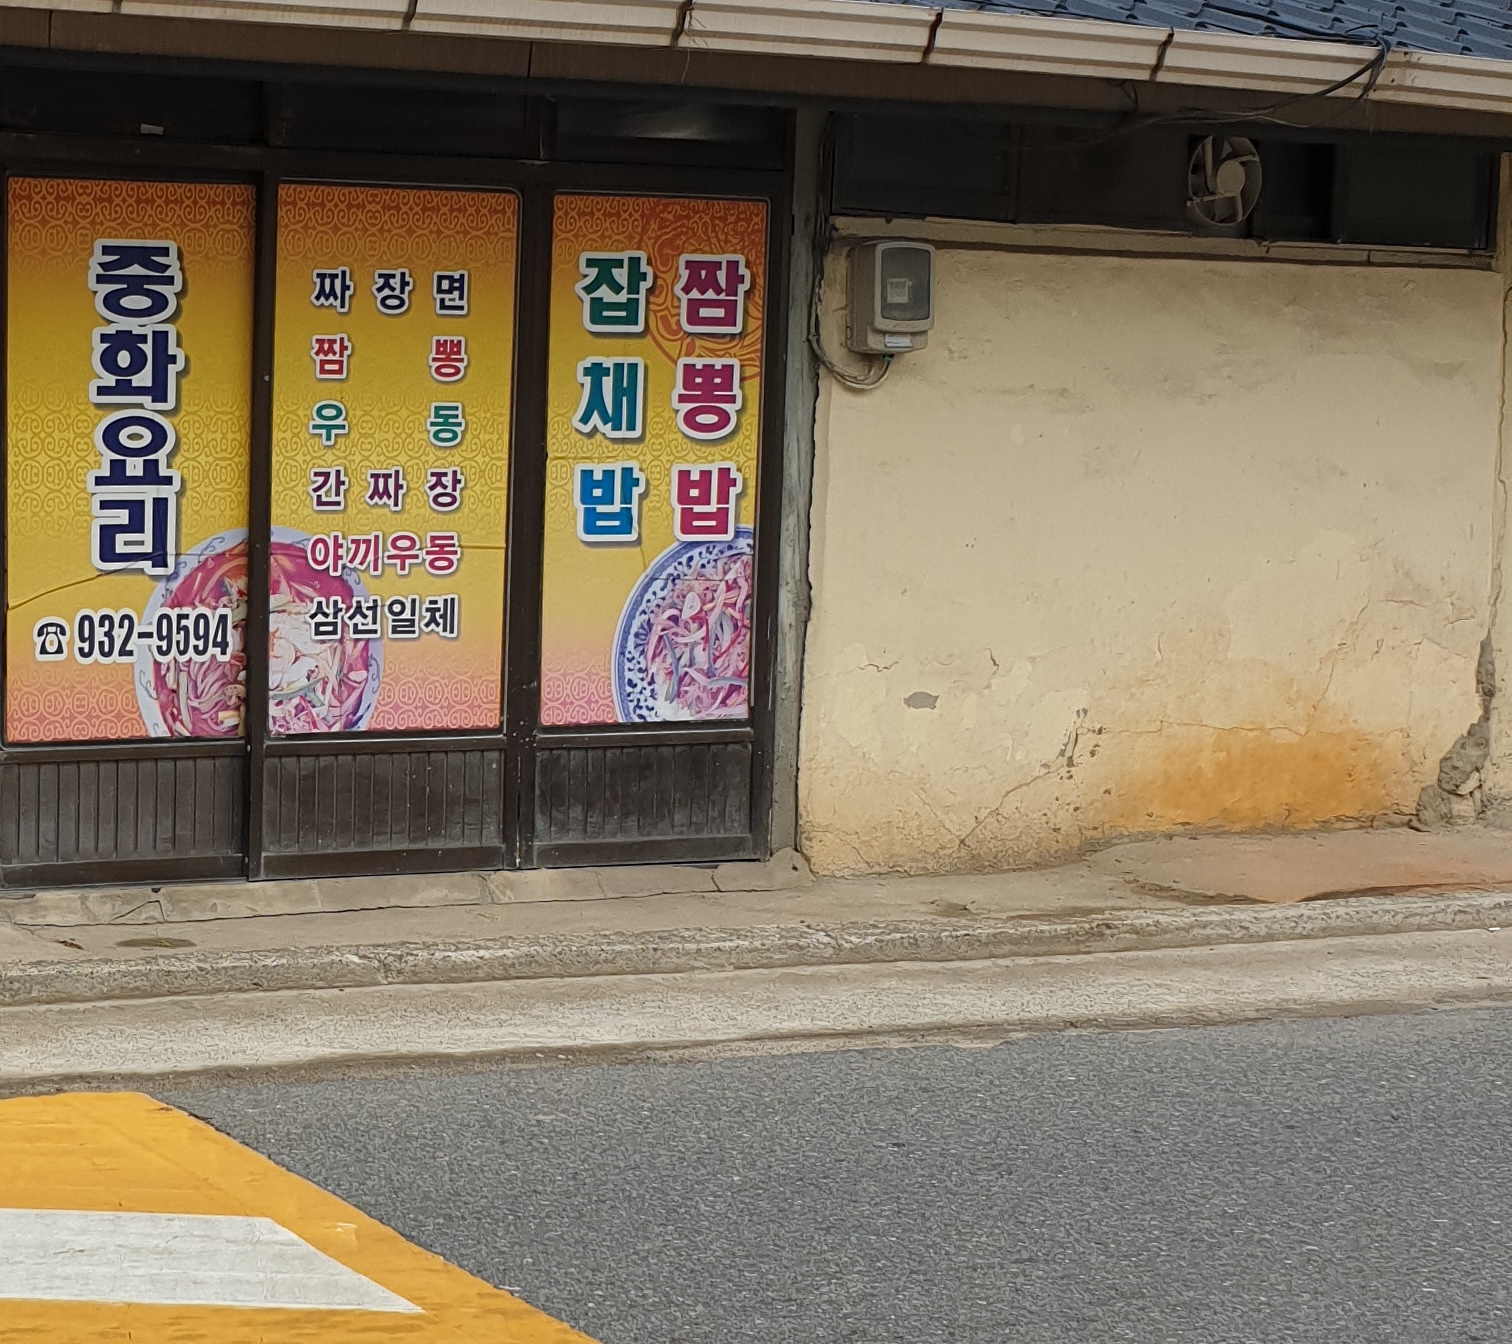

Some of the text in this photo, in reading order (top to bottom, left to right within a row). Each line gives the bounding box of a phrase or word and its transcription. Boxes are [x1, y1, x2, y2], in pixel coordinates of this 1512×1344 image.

[312, 268, 467, 314] 짜장면
[312, 337, 468, 379] 짬뽕
[93, 242, 178, 570] 중화요리
[575, 254, 650, 538] 잡채밥
[674, 257, 747, 538] 짬뽕밥
[309, 403, 465, 445] 우동
[309, 470, 463, 511] 간짜장
[308, 534, 461, 574] 야끼우동
[76, 610, 230, 660] 932-9594
[307, 598, 459, 638] 삼선일체
